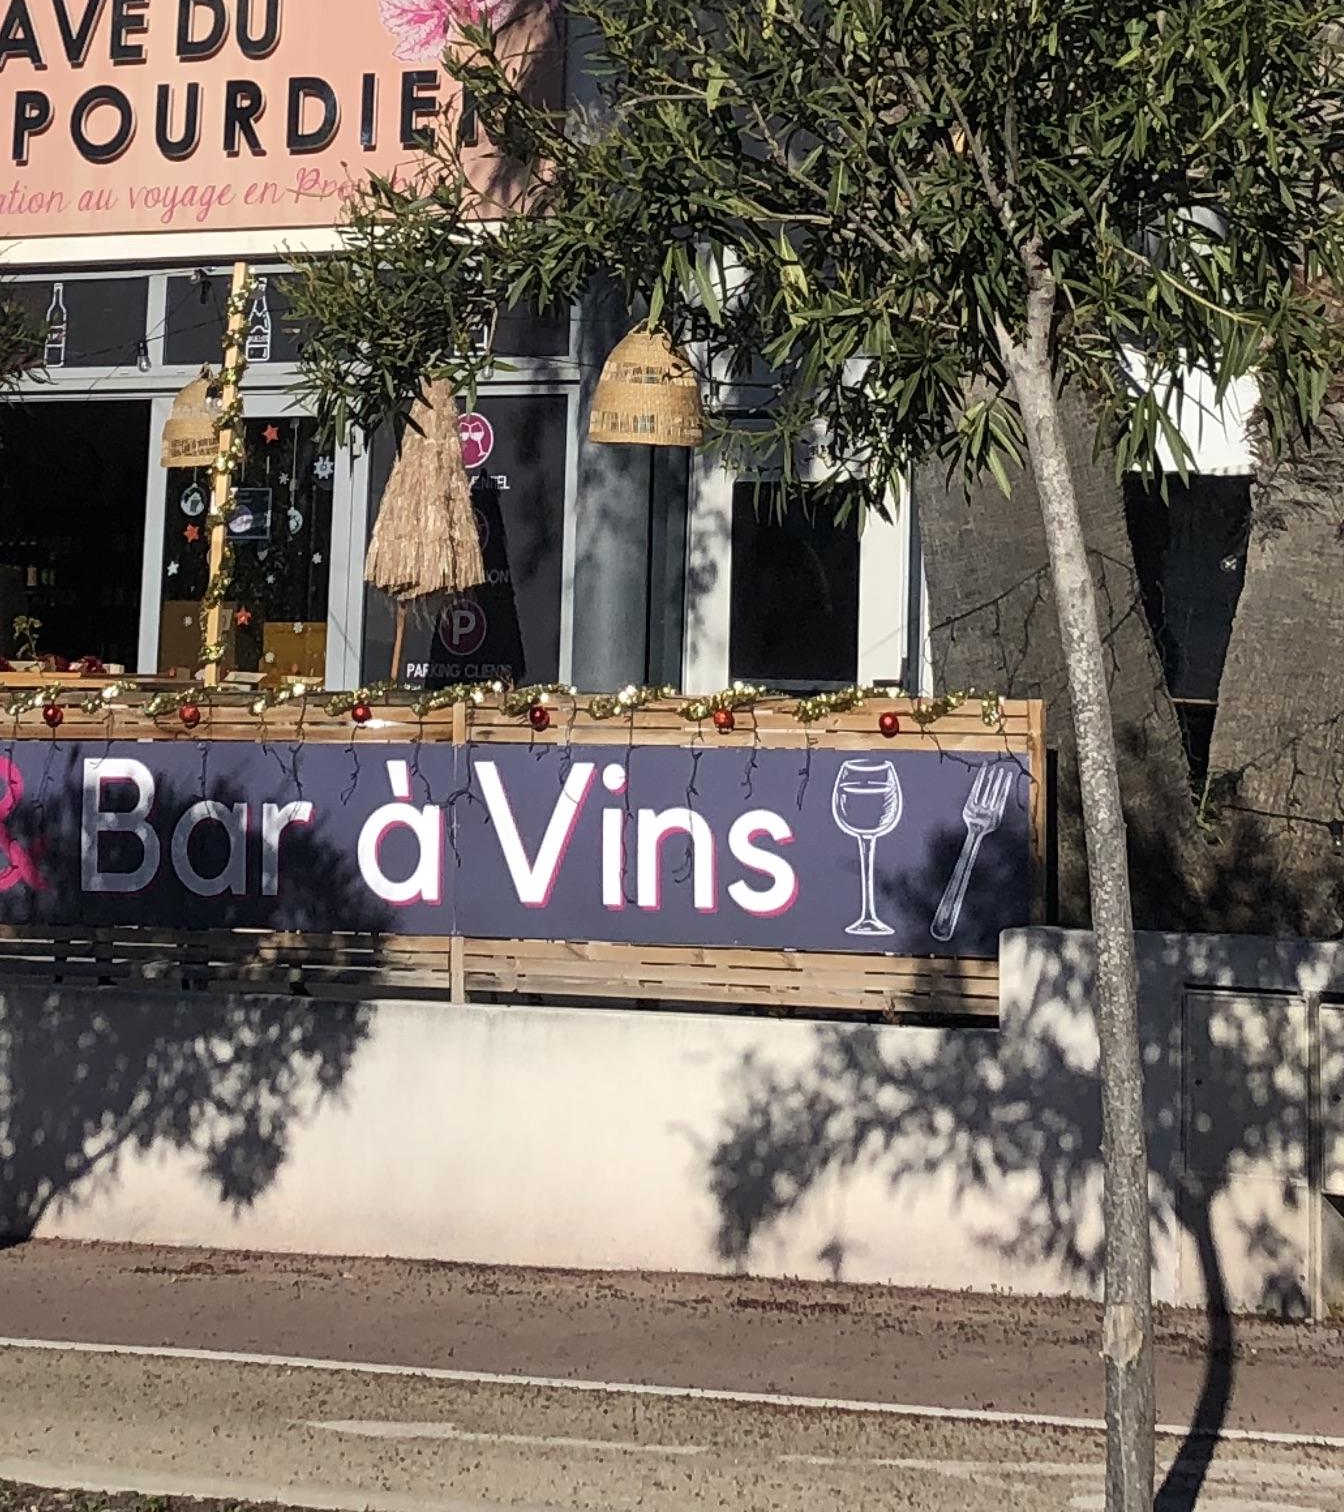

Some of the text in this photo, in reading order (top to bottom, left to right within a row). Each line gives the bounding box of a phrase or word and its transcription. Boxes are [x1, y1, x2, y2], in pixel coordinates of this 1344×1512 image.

[77, 186, 119, 212] au
[129, 180, 233, 224] voyage
[244, 181, 288, 207] en
[81, 757, 314, 897] Bar
[357, 760, 443, 906] à
[473, 760, 800, 918] Vins
